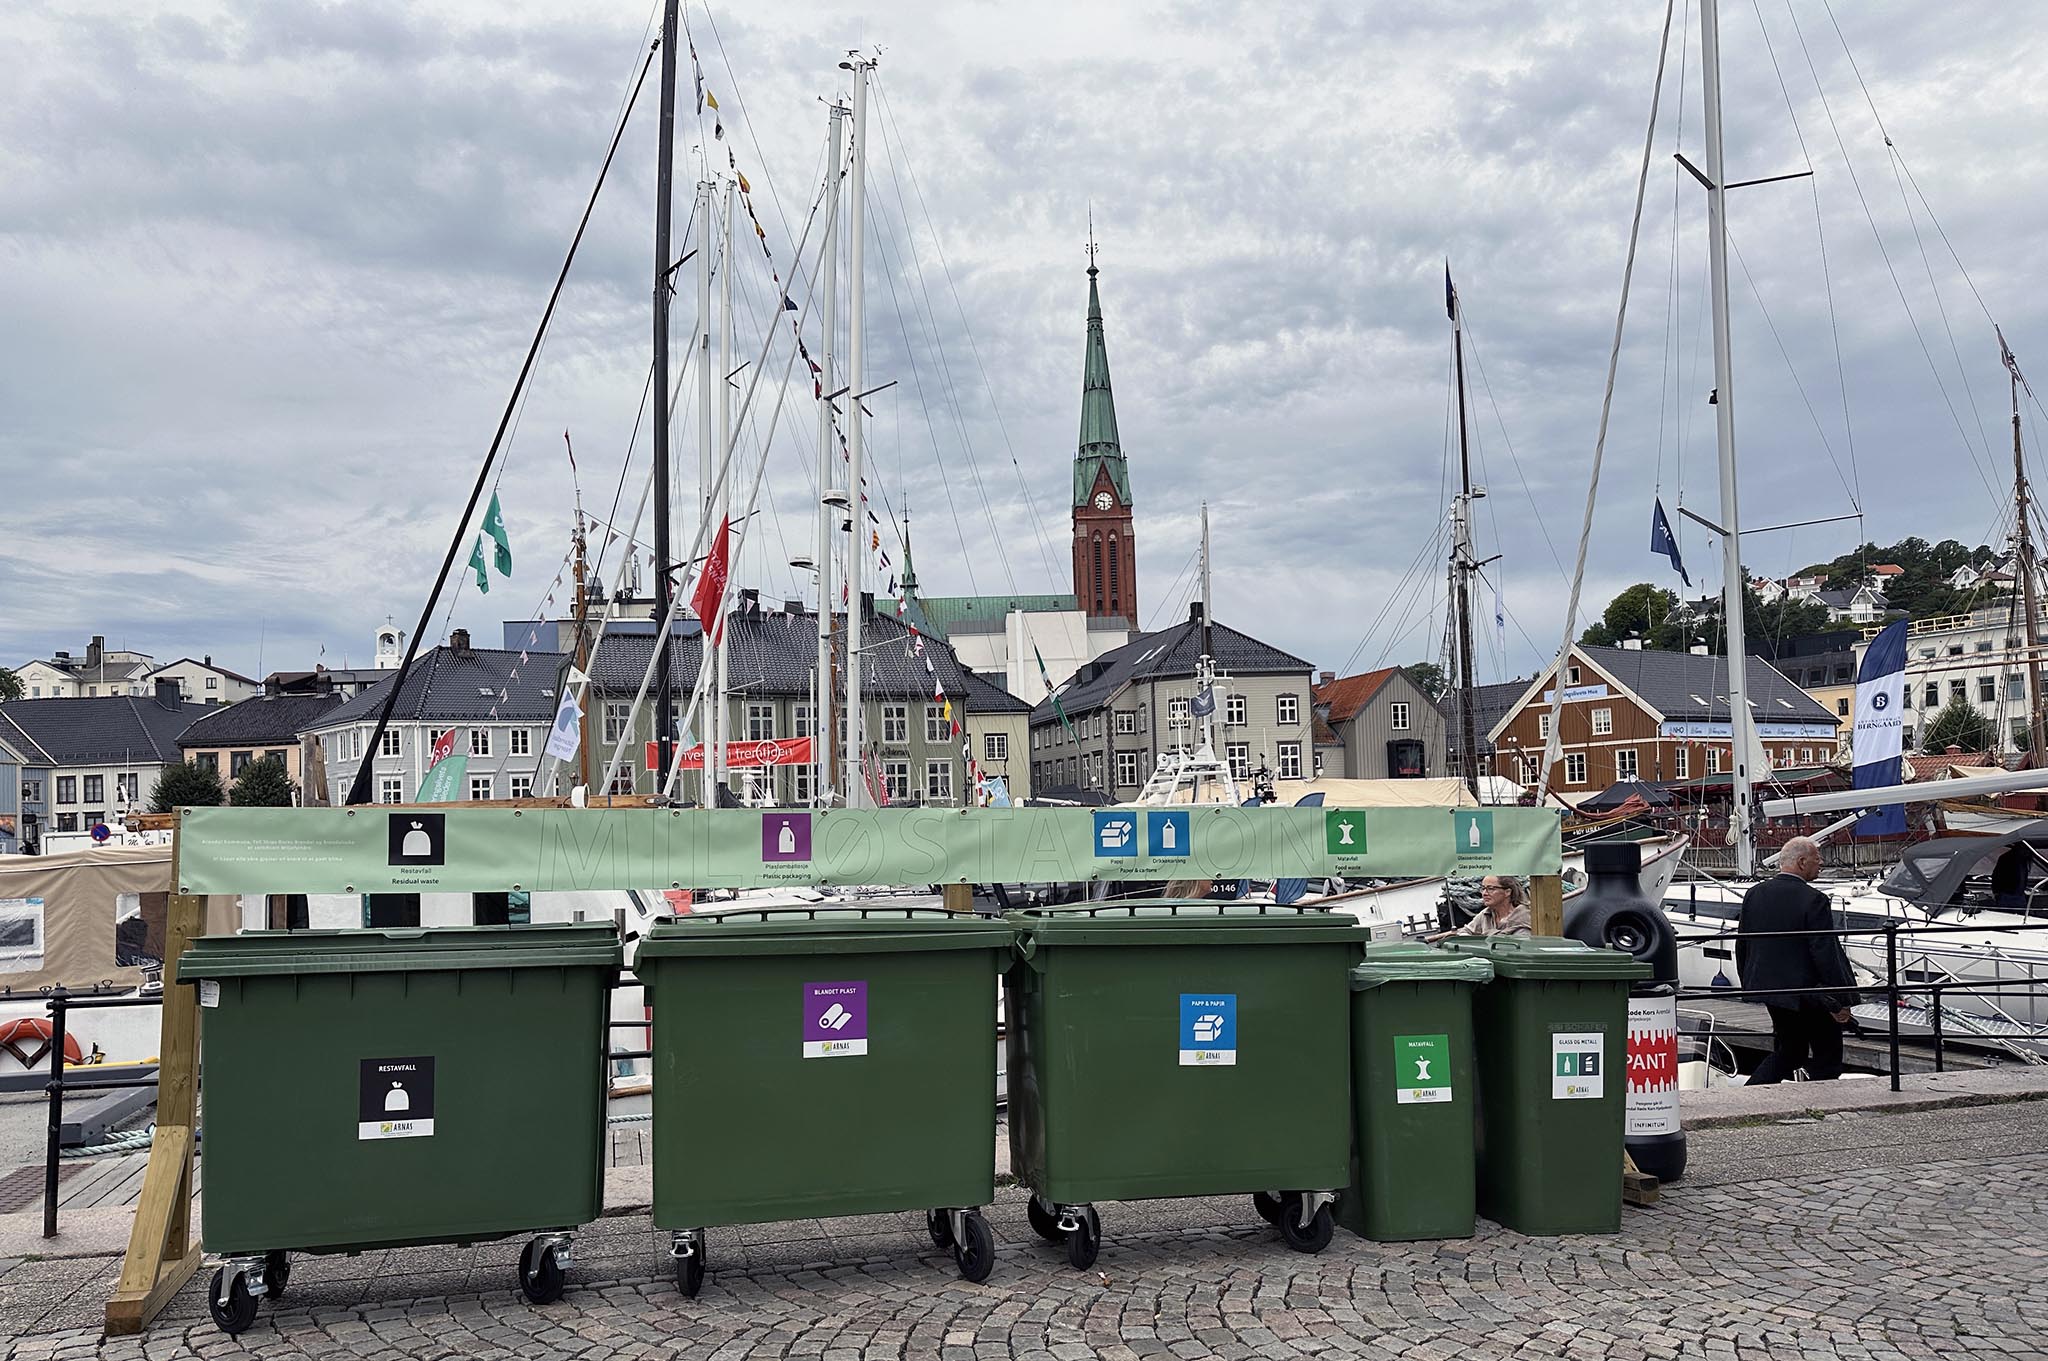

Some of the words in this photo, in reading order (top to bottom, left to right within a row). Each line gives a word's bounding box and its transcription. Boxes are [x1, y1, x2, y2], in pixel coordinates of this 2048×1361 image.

[735, 746, 793, 760] fremtiden
[1220, 884, 1236, 893] 146
[1626, 1052, 1667, 1070] PANT
[378, 1064, 417, 1072] RESTAVFALL
[393, 1122, 413, 1132] ARNAS
